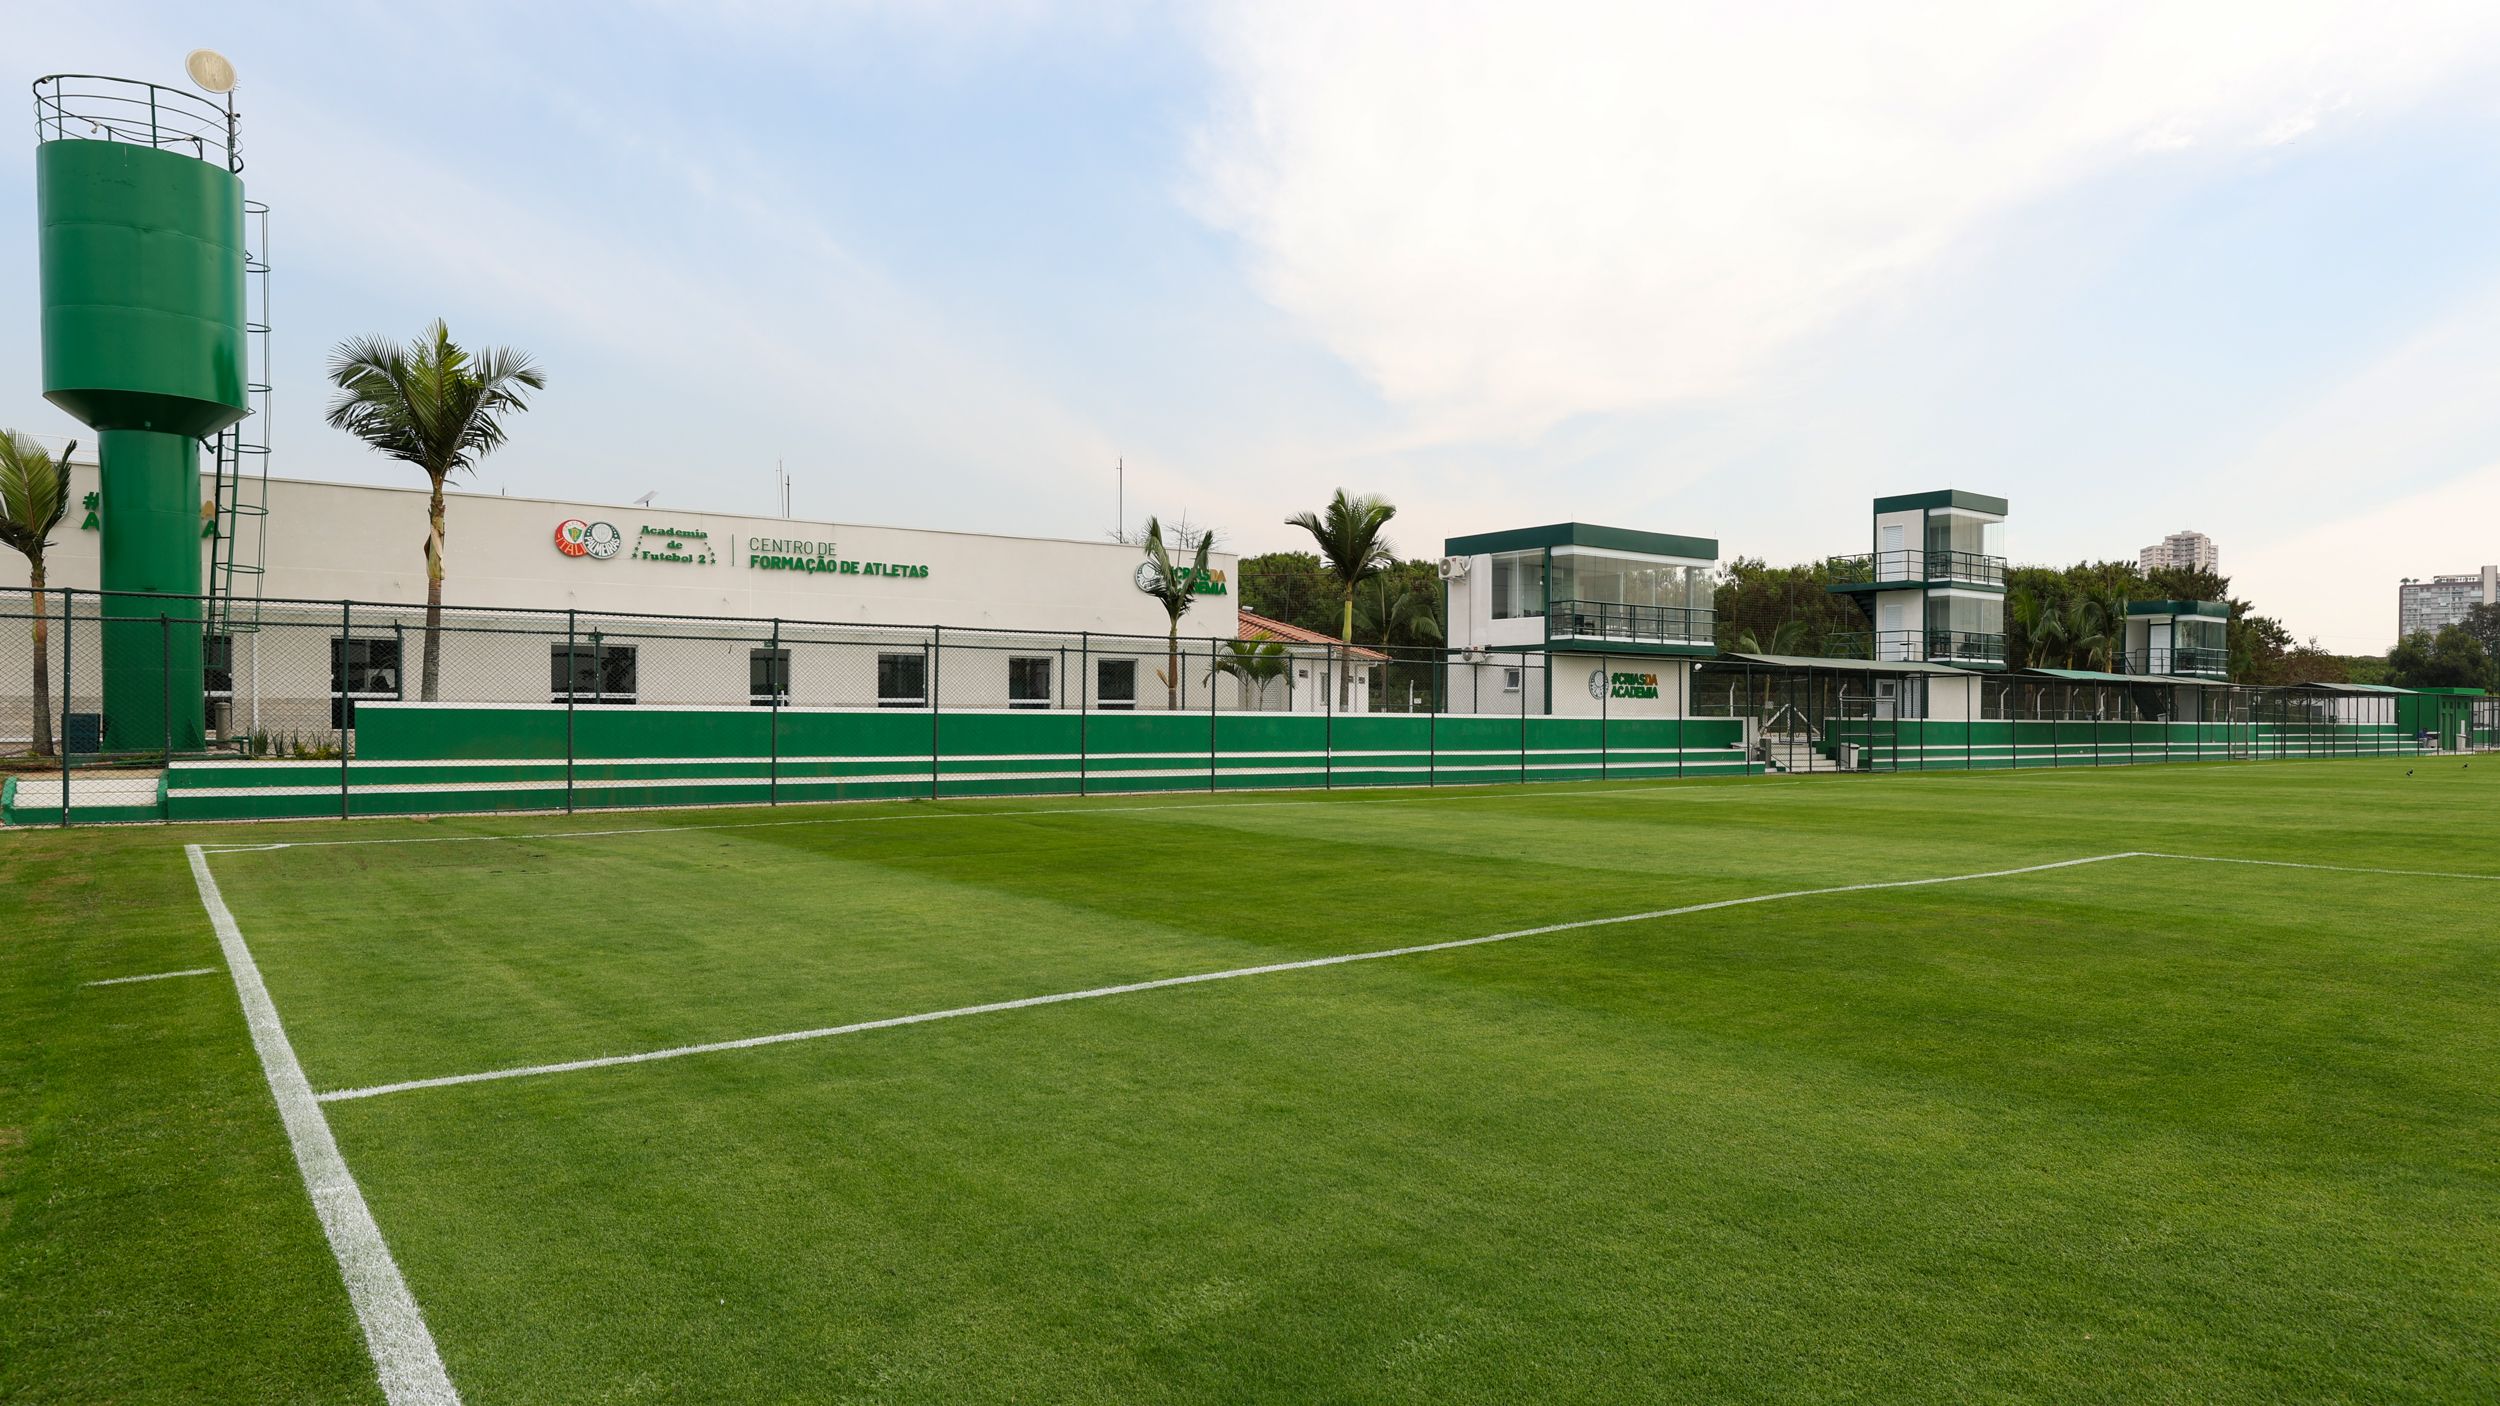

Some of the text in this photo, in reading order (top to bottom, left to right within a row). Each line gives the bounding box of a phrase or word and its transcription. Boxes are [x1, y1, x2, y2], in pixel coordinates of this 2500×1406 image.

[640, 525, 708, 539] Academia
[585, 536, 620, 557] PALMEIRAS
[666, 540, 683, 550] de
[749, 537, 837, 556] CENTRO DE
[642, 550, 706, 565] Futebol 2
[750, 555, 929, 578] FORMAÇÃO DE ATLETAS
